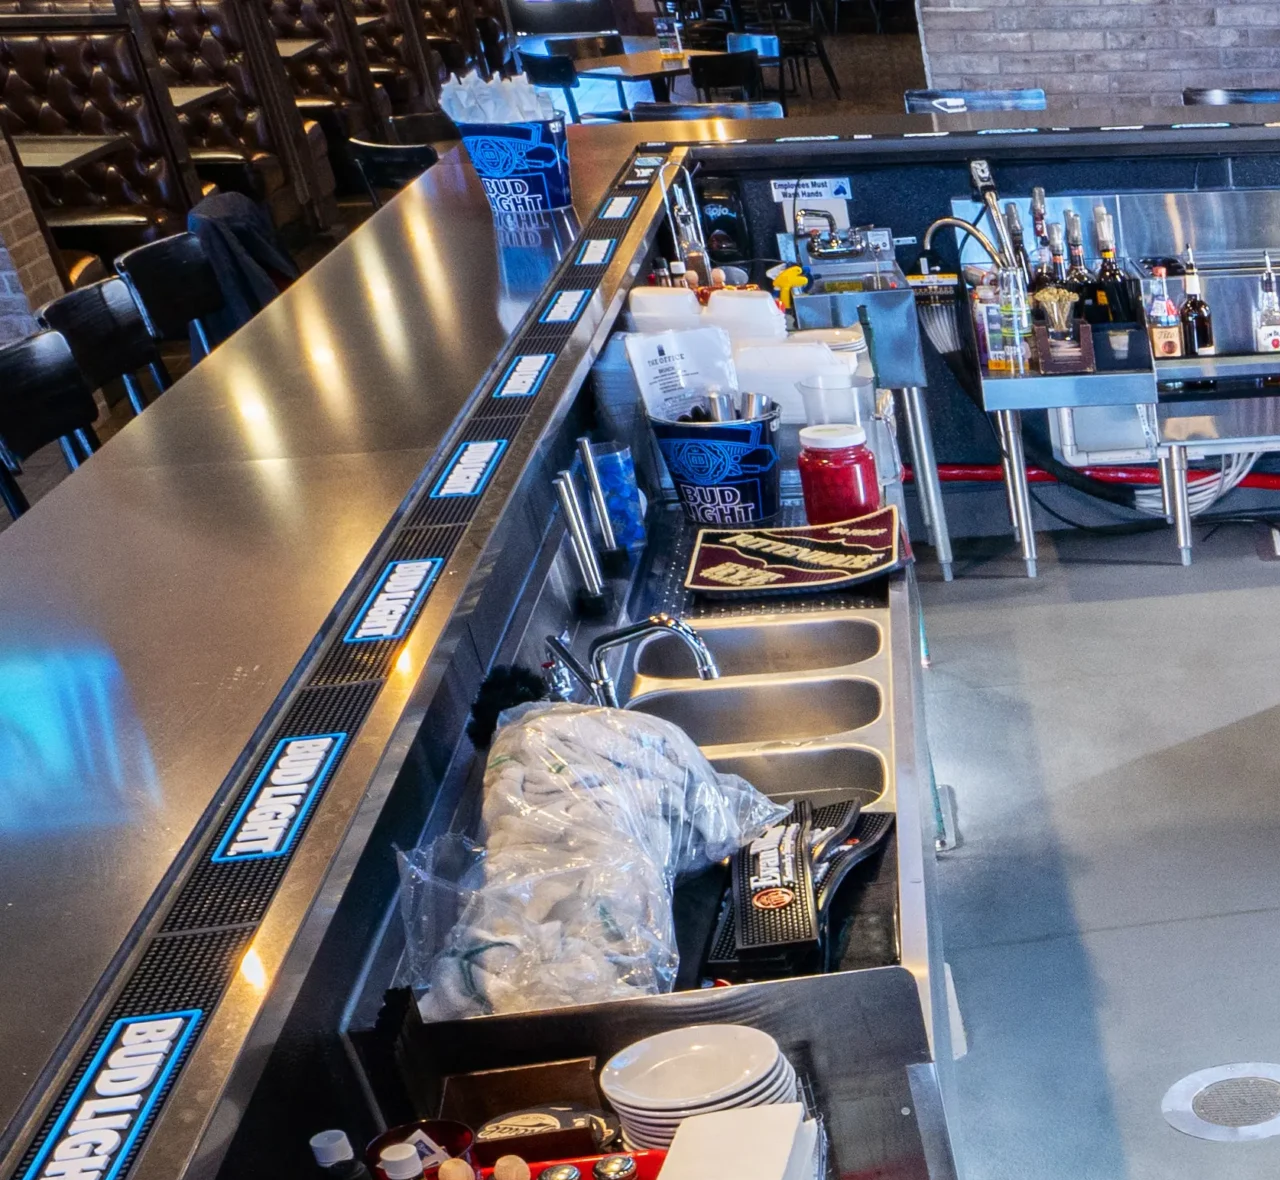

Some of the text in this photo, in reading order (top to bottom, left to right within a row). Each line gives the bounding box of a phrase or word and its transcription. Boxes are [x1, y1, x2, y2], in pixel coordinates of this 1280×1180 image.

[481, 178, 529, 196] BUD
[773, 181, 828, 191] Employees Must
[801, 189, 823, 198] Hands
[680, 484, 741, 505] BUD
[355, 561, 432, 636] BUD LIGHT
[227, 737, 333, 856] BUD LIGHT
[750, 847, 782, 890] Evan
[95, 1017, 185, 1097] BUD
